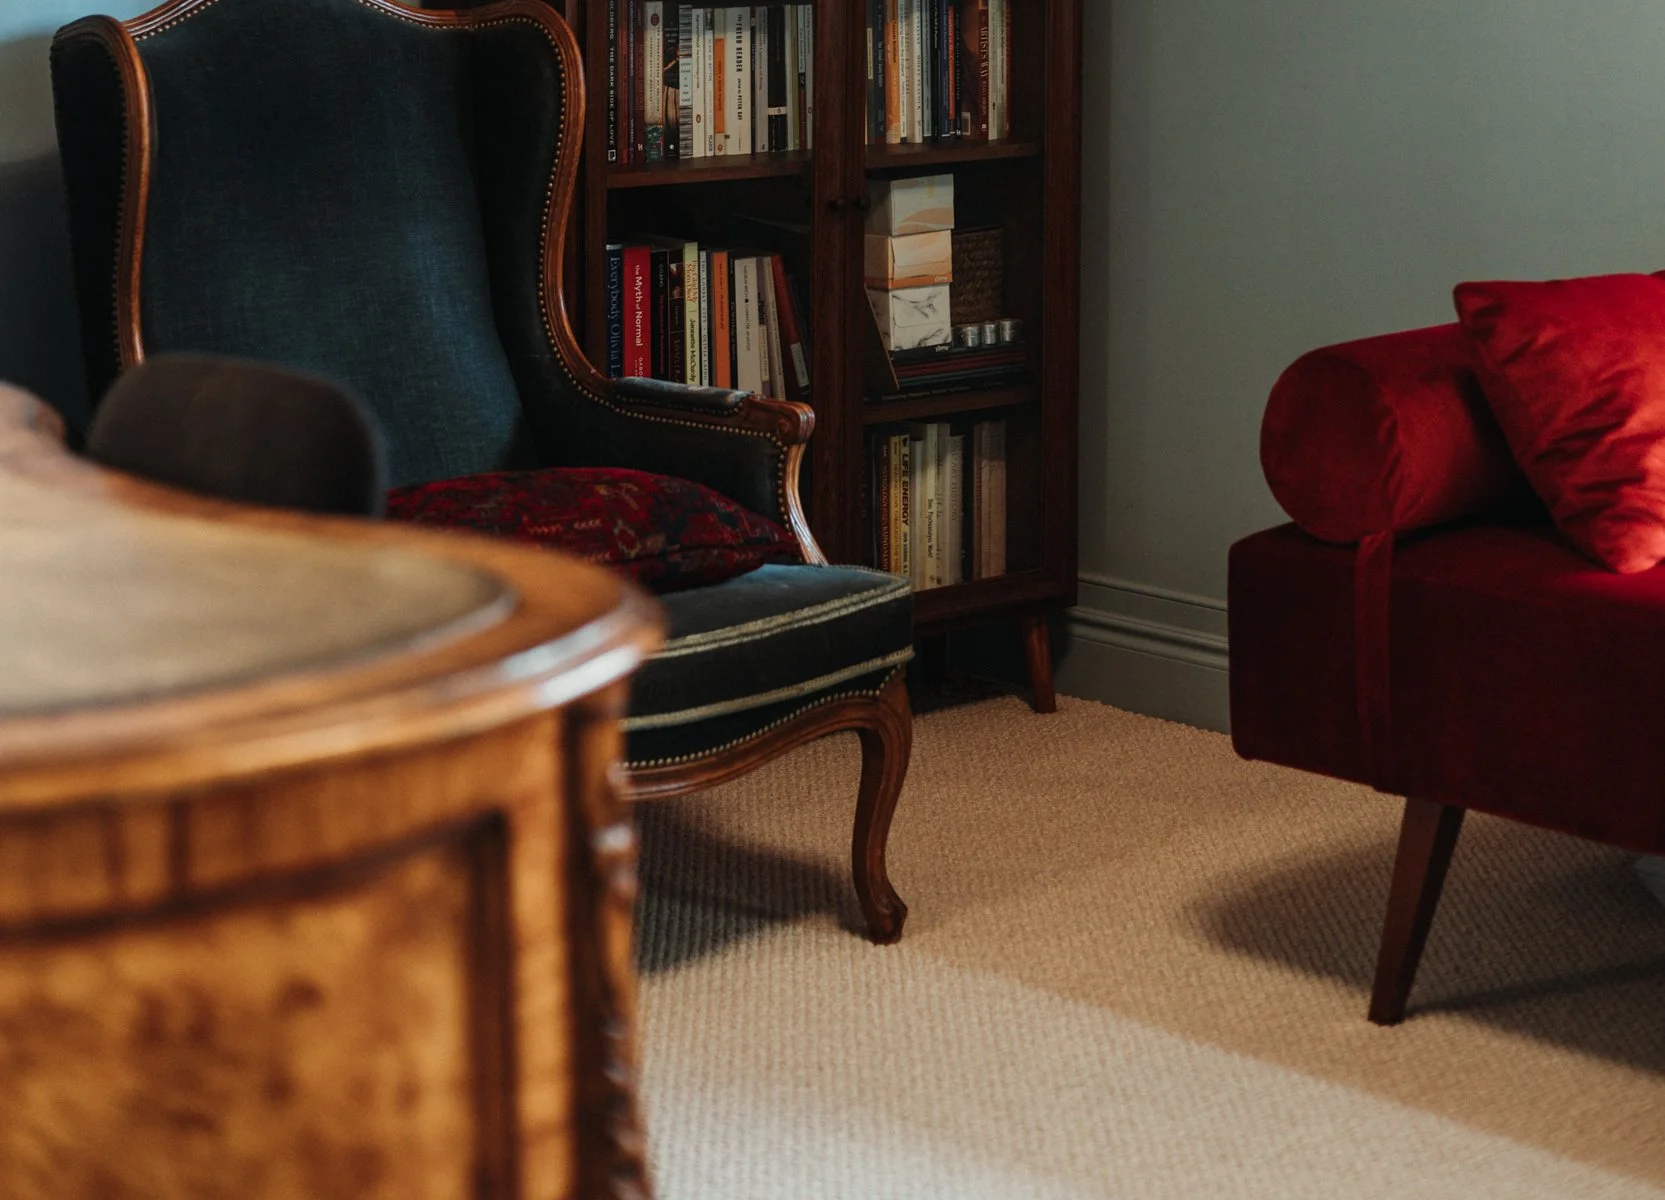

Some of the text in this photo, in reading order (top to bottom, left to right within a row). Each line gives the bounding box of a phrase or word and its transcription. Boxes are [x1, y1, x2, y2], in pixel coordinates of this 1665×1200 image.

[609, 111, 615, 122] OF
[607, 256, 620, 319] Everybody
[634, 276, 643, 303] Myth
[610, 324, 620, 360] Olivia
[635, 311, 643, 347] Normal
